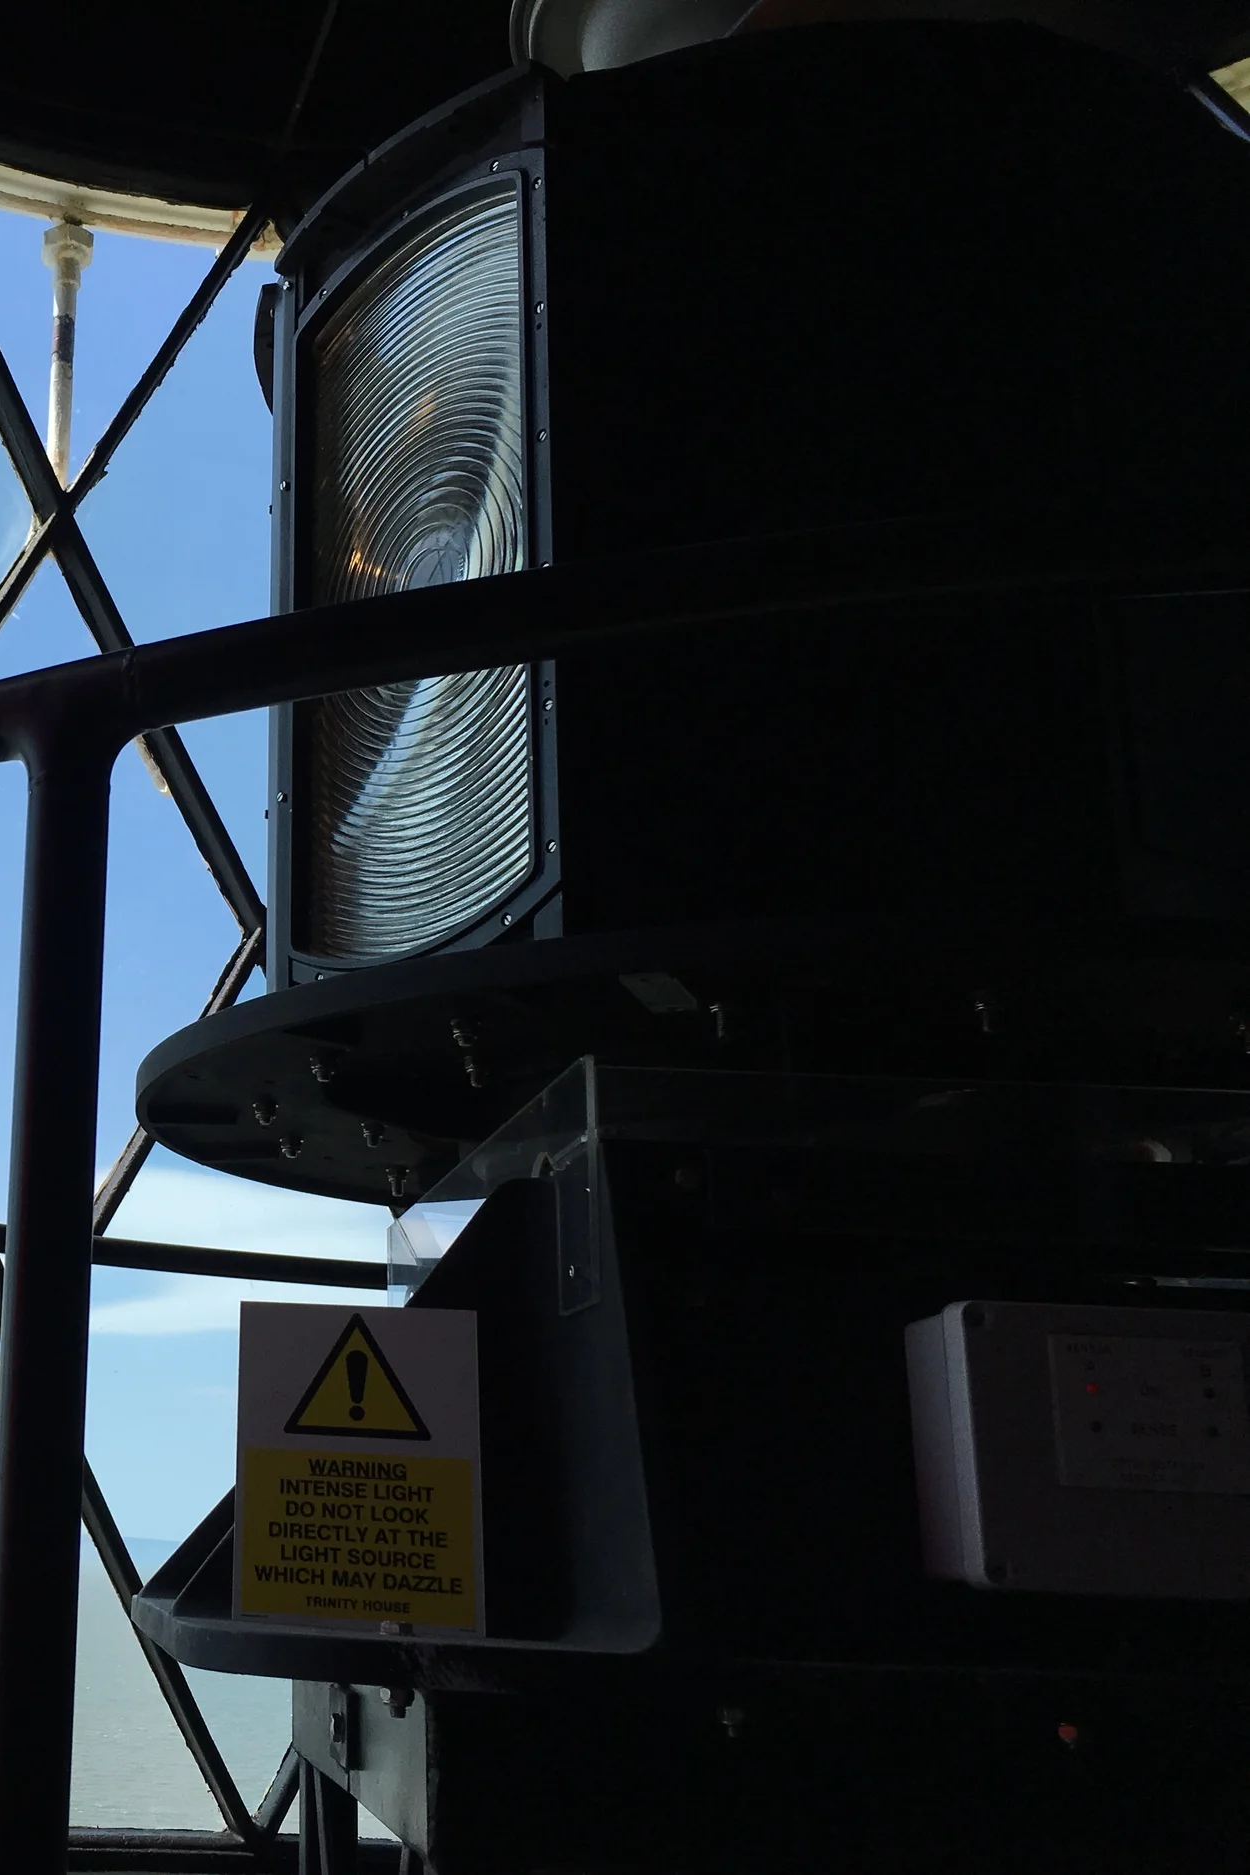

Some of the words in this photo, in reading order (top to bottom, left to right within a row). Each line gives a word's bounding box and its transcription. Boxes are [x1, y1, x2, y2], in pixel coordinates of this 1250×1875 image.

[308, 1458, 407, 1481] WARNING
[280, 1479, 368, 1498] INTENSE
[373, 1484, 434, 1502] LIGHT
[285, 1500, 315, 1517] DO
[322, 1503, 364, 1520] NOT
[371, 1505, 429, 1525] LOOK
[268, 1521, 368, 1543] DIRECTLY
[374, 1528, 401, 1545] AT
[408, 1530, 448, 1548] THE
[281, 1544, 341, 1563] LIGHT
[347, 1549, 436, 1570] SOURCE
[255, 1565, 325, 1585] WHICH
[332, 1570, 376, 1589] MAY
[383, 1573, 463, 1595] DAZZLE
[306, 1596, 358, 1609] TRINITY
[363, 1600, 411, 1613] HOUSE
